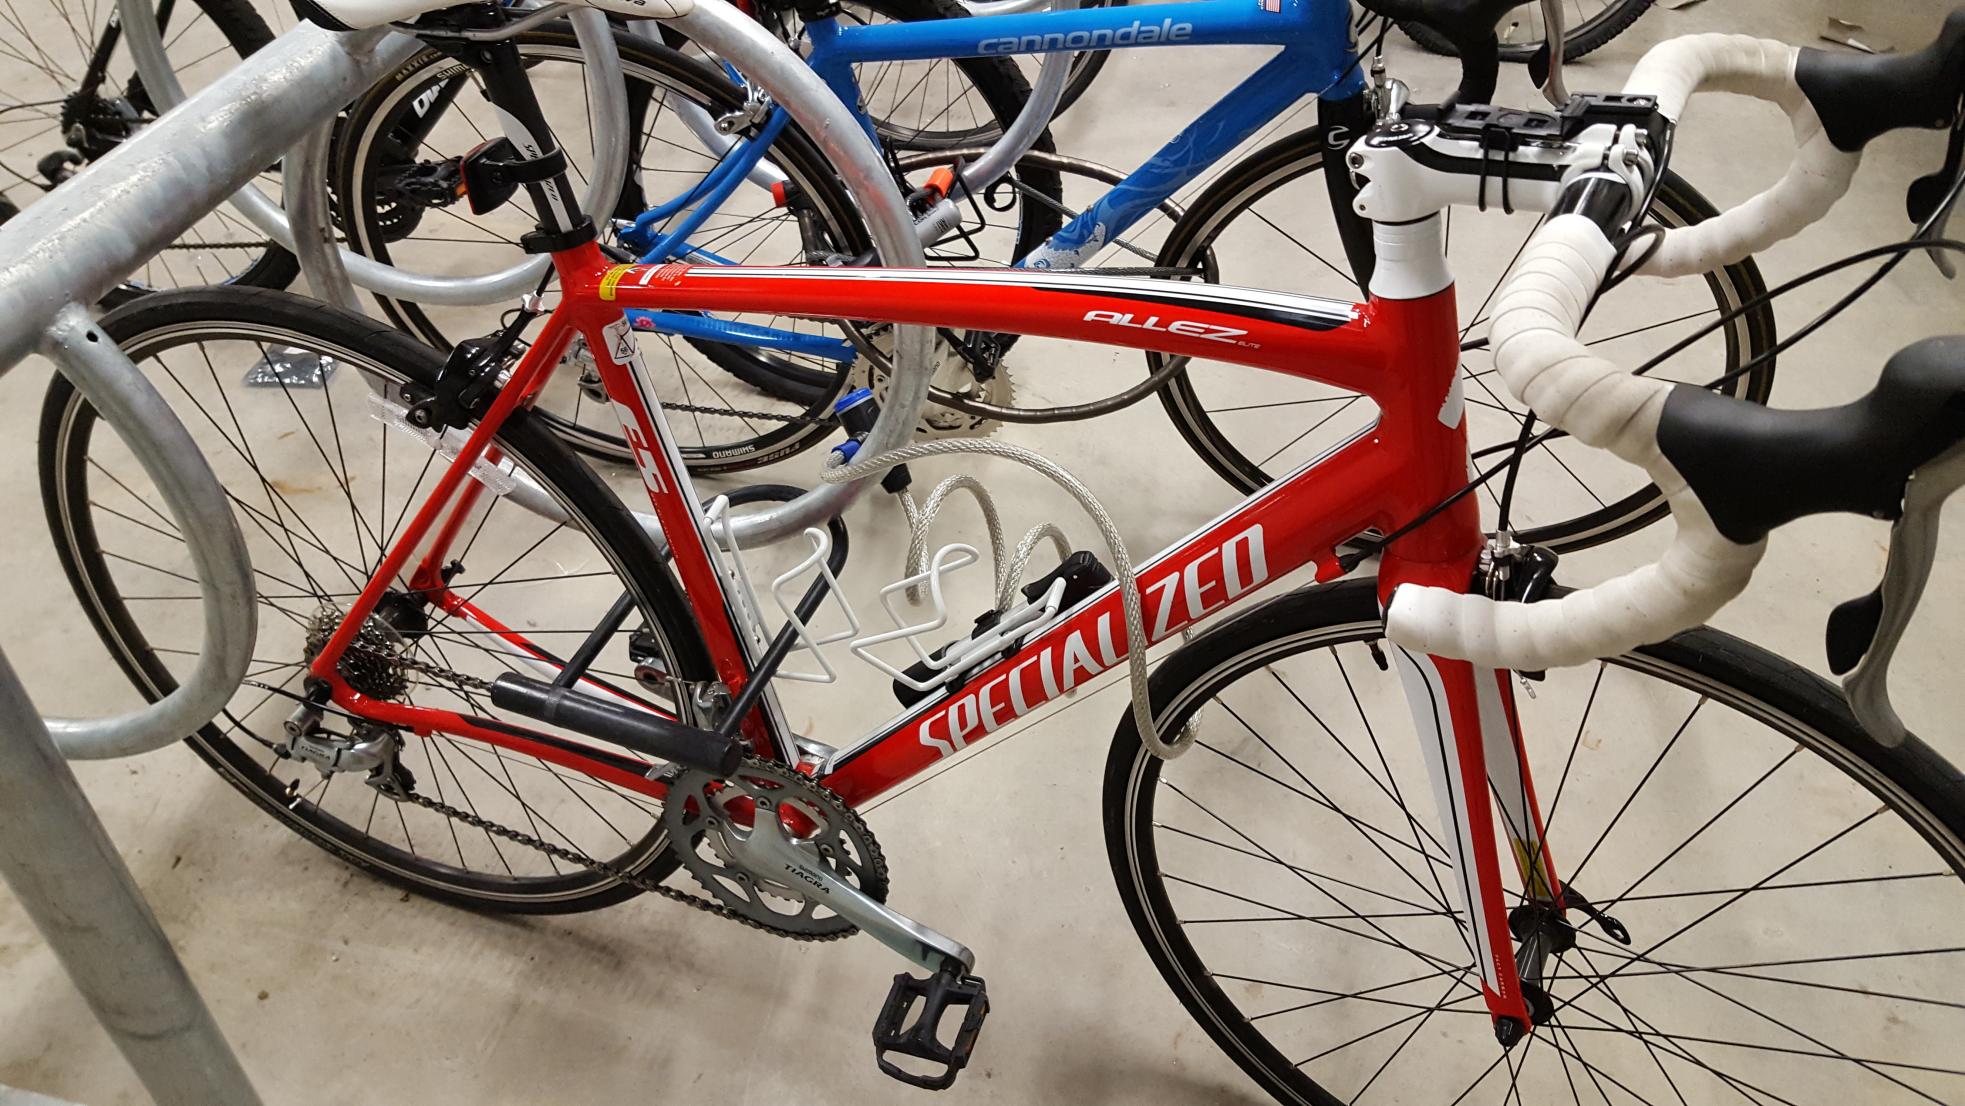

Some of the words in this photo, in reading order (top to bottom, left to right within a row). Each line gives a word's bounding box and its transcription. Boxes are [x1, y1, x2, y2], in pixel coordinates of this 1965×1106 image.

[978, 18, 1193, 54] cannondale
[1083, 310, 1248, 344] ALLEZ
[712, 444, 756, 459] SHIMANO
[919, 523, 1270, 759] SPECIALZED
[784, 863, 830, 894] TIAGRA
